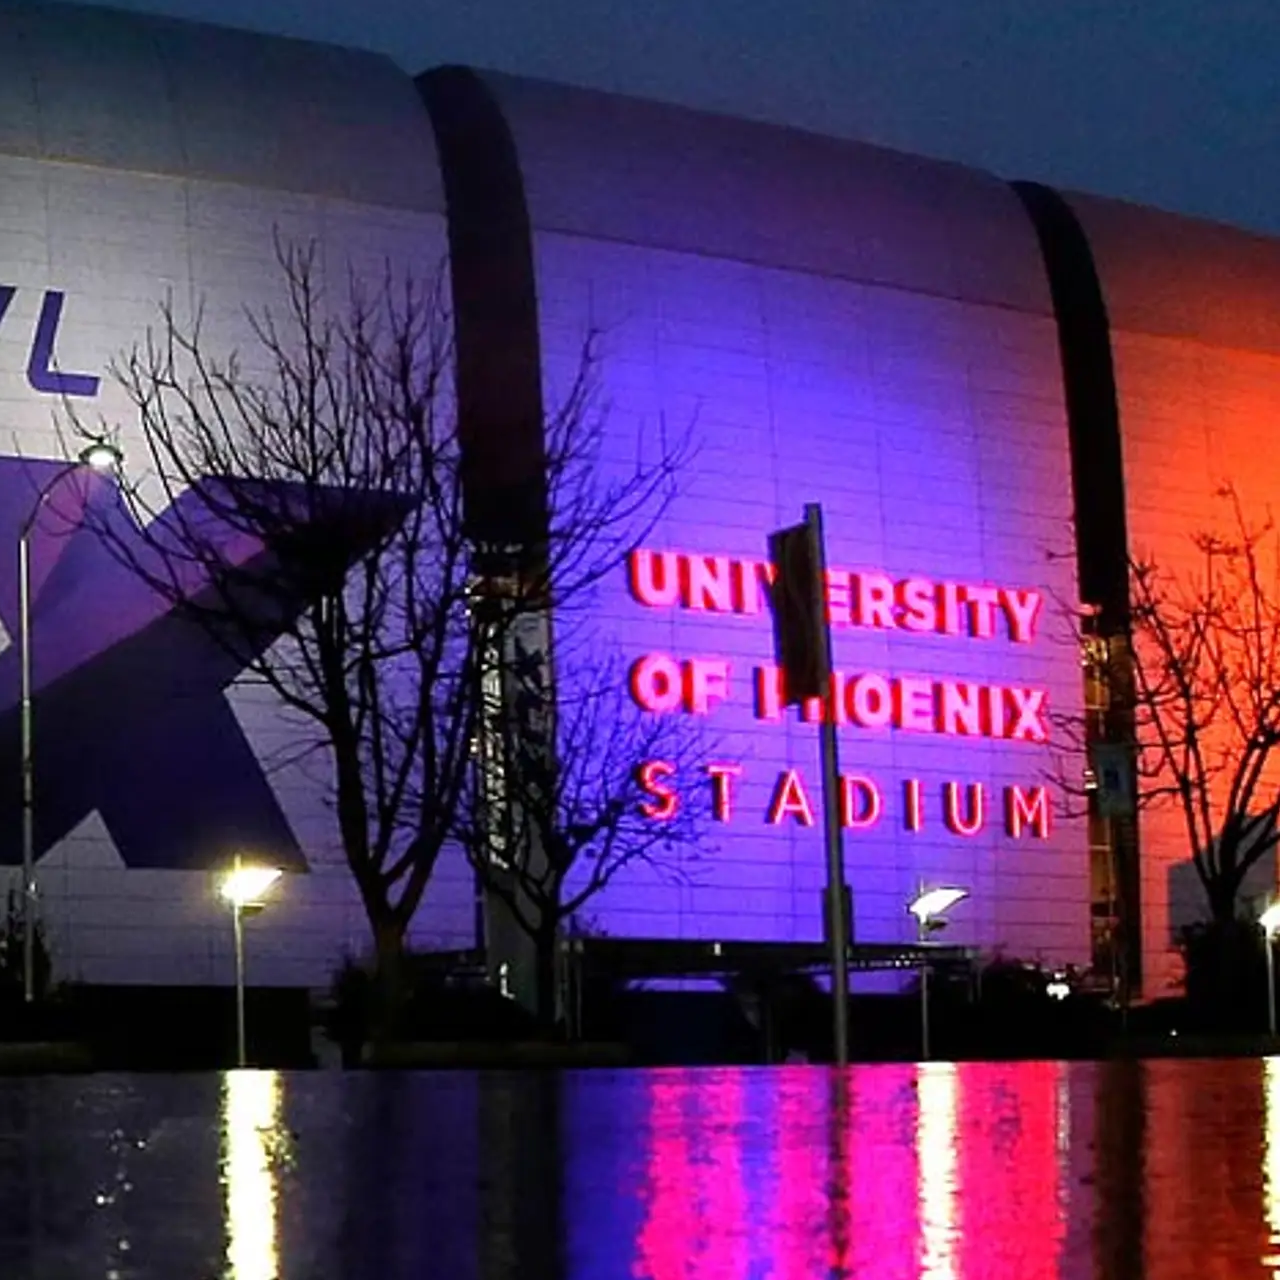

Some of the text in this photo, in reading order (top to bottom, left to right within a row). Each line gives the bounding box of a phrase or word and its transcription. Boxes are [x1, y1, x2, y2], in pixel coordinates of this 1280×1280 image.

[631, 549, 1040, 642] UNIERSITY
[632, 654, 730, 715] OF
[639, 760, 1049, 839] STADIUM
